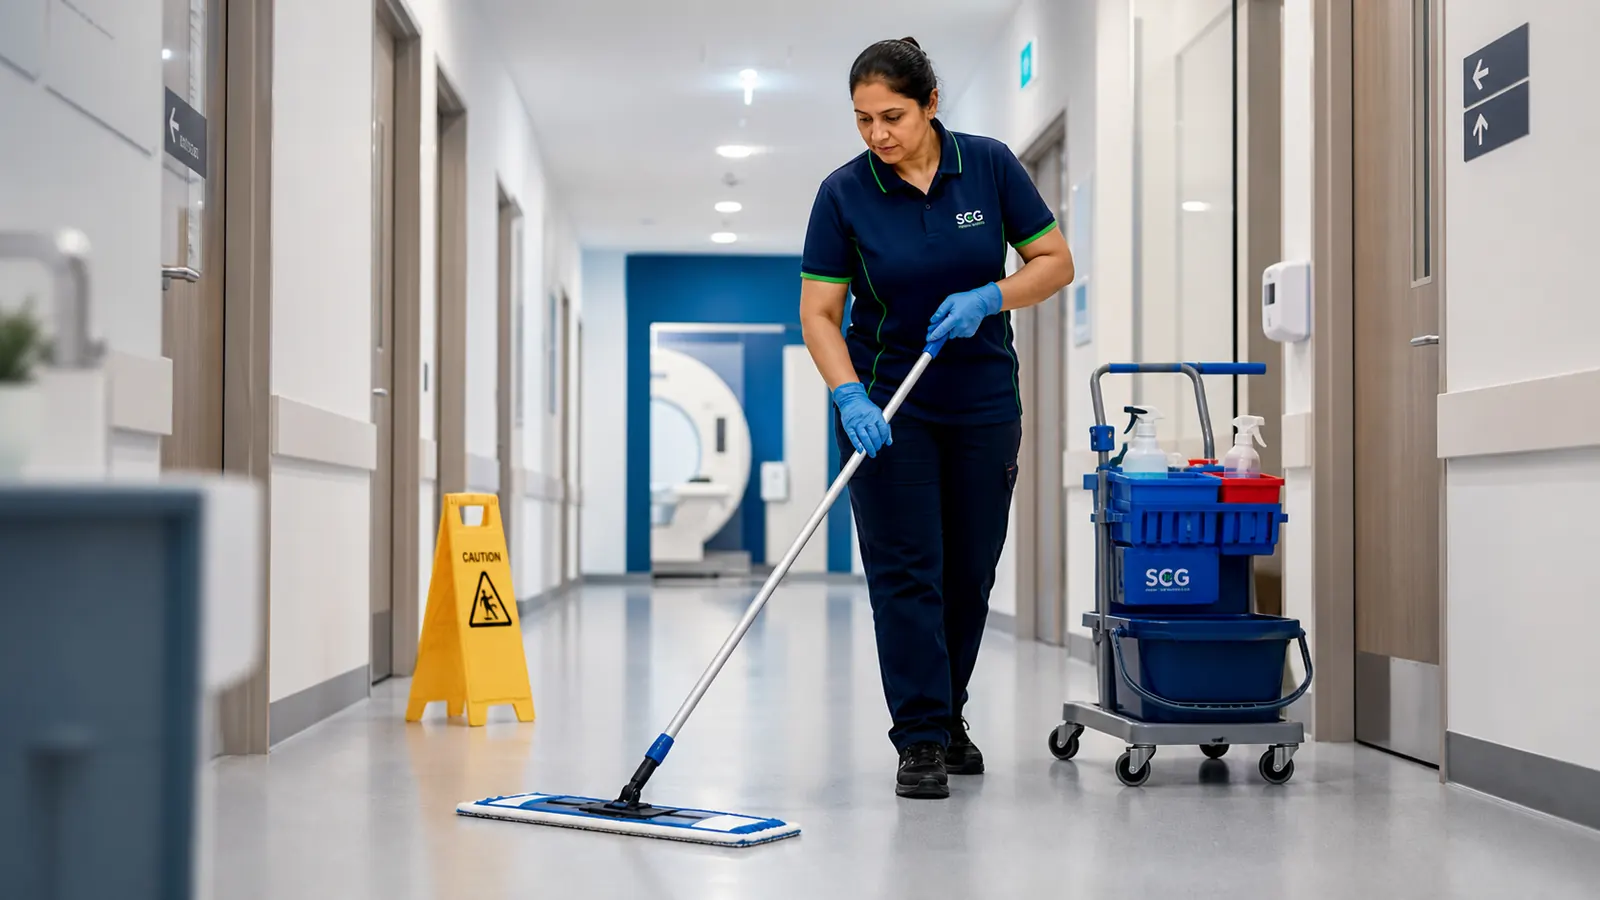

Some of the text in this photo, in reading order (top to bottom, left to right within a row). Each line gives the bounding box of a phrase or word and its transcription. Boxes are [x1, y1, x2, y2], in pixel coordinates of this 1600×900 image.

[955, 210, 984, 225] SCG
[462, 551, 502, 563] CAUTION
[1145, 568, 1190, 587] SCG
